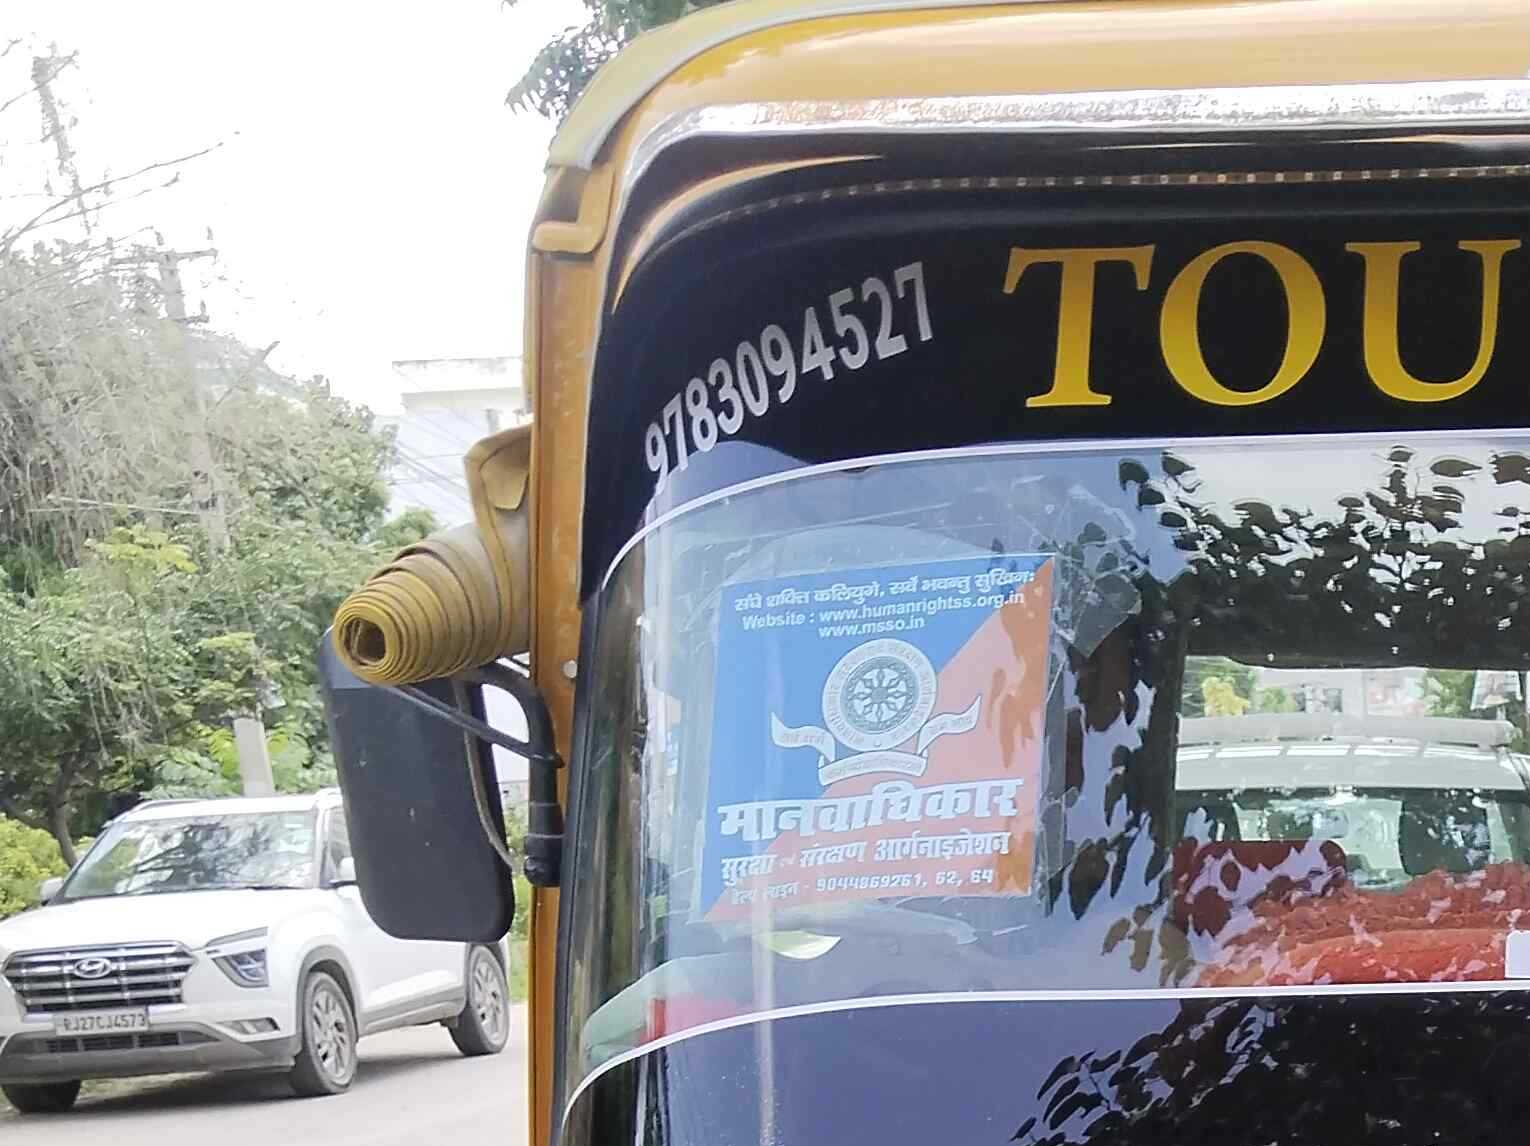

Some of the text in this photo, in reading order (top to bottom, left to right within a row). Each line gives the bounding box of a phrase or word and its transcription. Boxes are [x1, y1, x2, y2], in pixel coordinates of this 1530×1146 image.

[645, 261, 933, 498] 9783094527
[742, 610, 805, 630] Website
[819, 590, 1025, 622] www.humanrightss.org.in
[817, 615, 925, 637] www.msso.in
[717, 779, 1023, 841] मानवाधिकार
[720, 854, 779, 886] सुरक्षा
[799, 842, 867, 868] संरक्षण
[970, 868, 993, 884] 64
